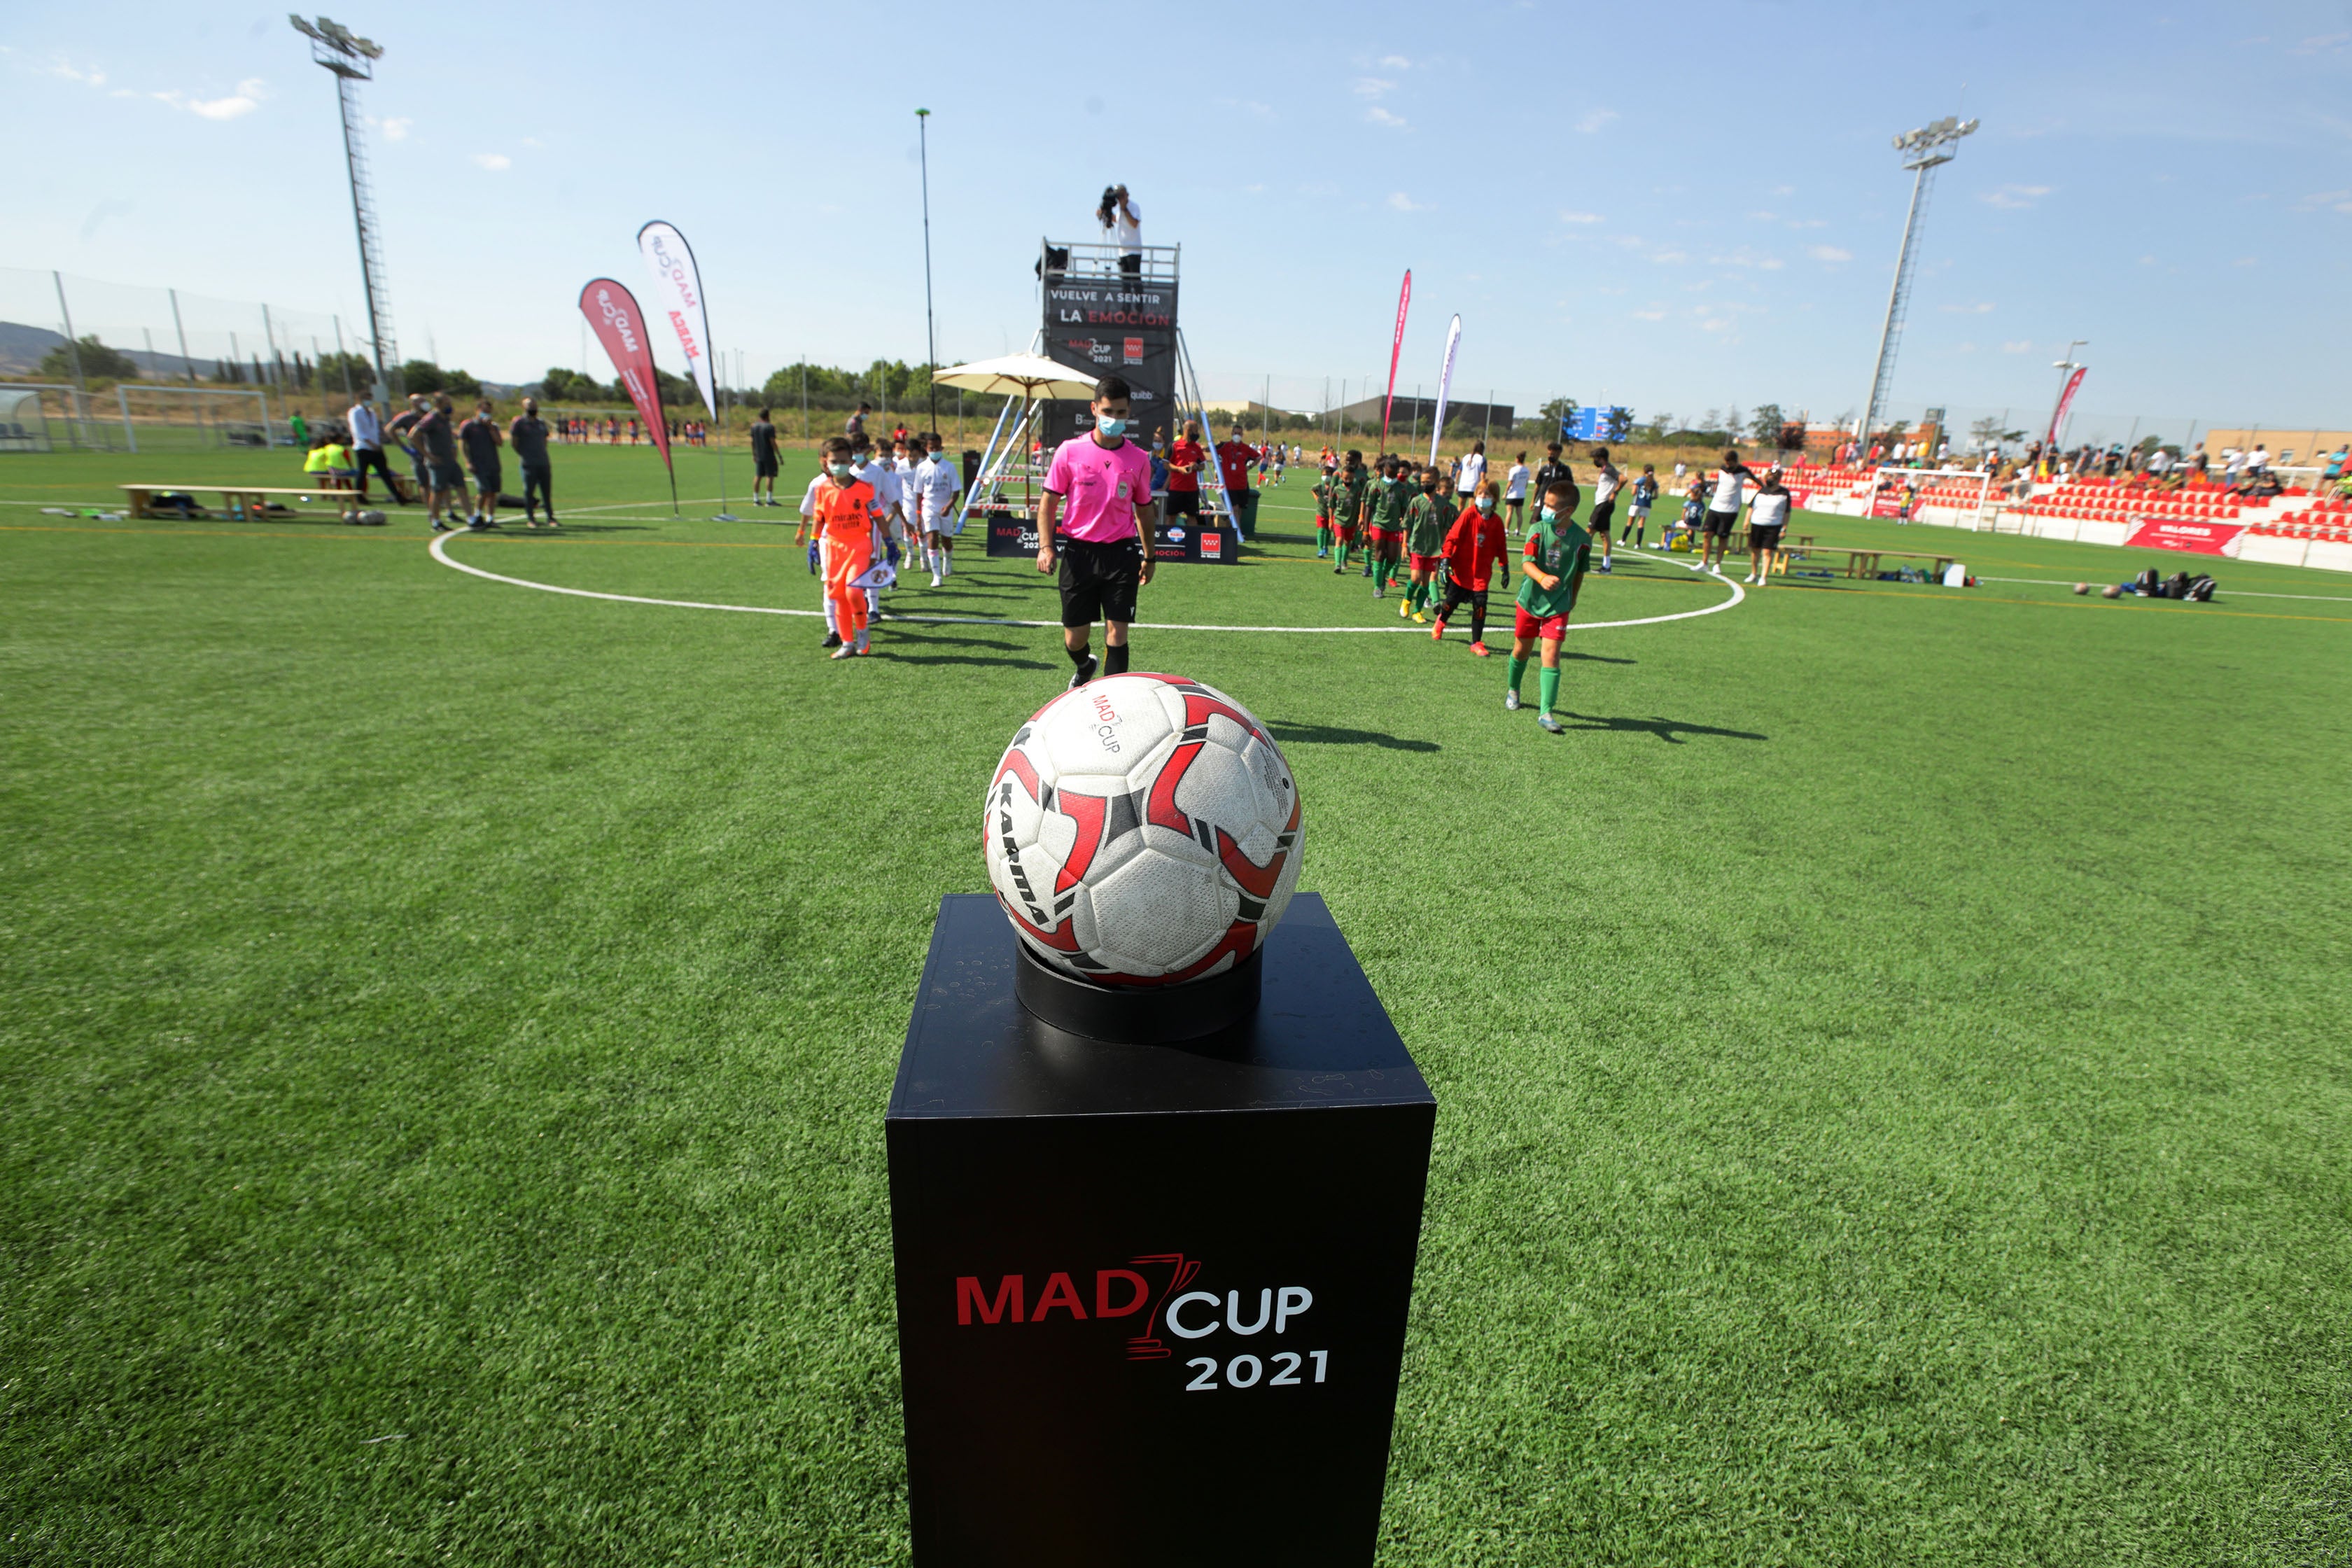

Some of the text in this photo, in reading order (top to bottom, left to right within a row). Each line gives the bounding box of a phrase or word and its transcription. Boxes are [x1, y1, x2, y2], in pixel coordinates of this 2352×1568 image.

[1051, 290, 1160, 303] VUELVE A SENTIR
[1060, 309, 1169, 326] LA EMOCIÓN
[1068, 339, 1111, 354] MAD CUP
[996, 527, 1020, 536] MAD
[1092, 694, 1120, 752] MAD CUP
[956, 1268, 1312, 1338] MAD CUP
[1185, 1350, 1328, 1391] 2021
